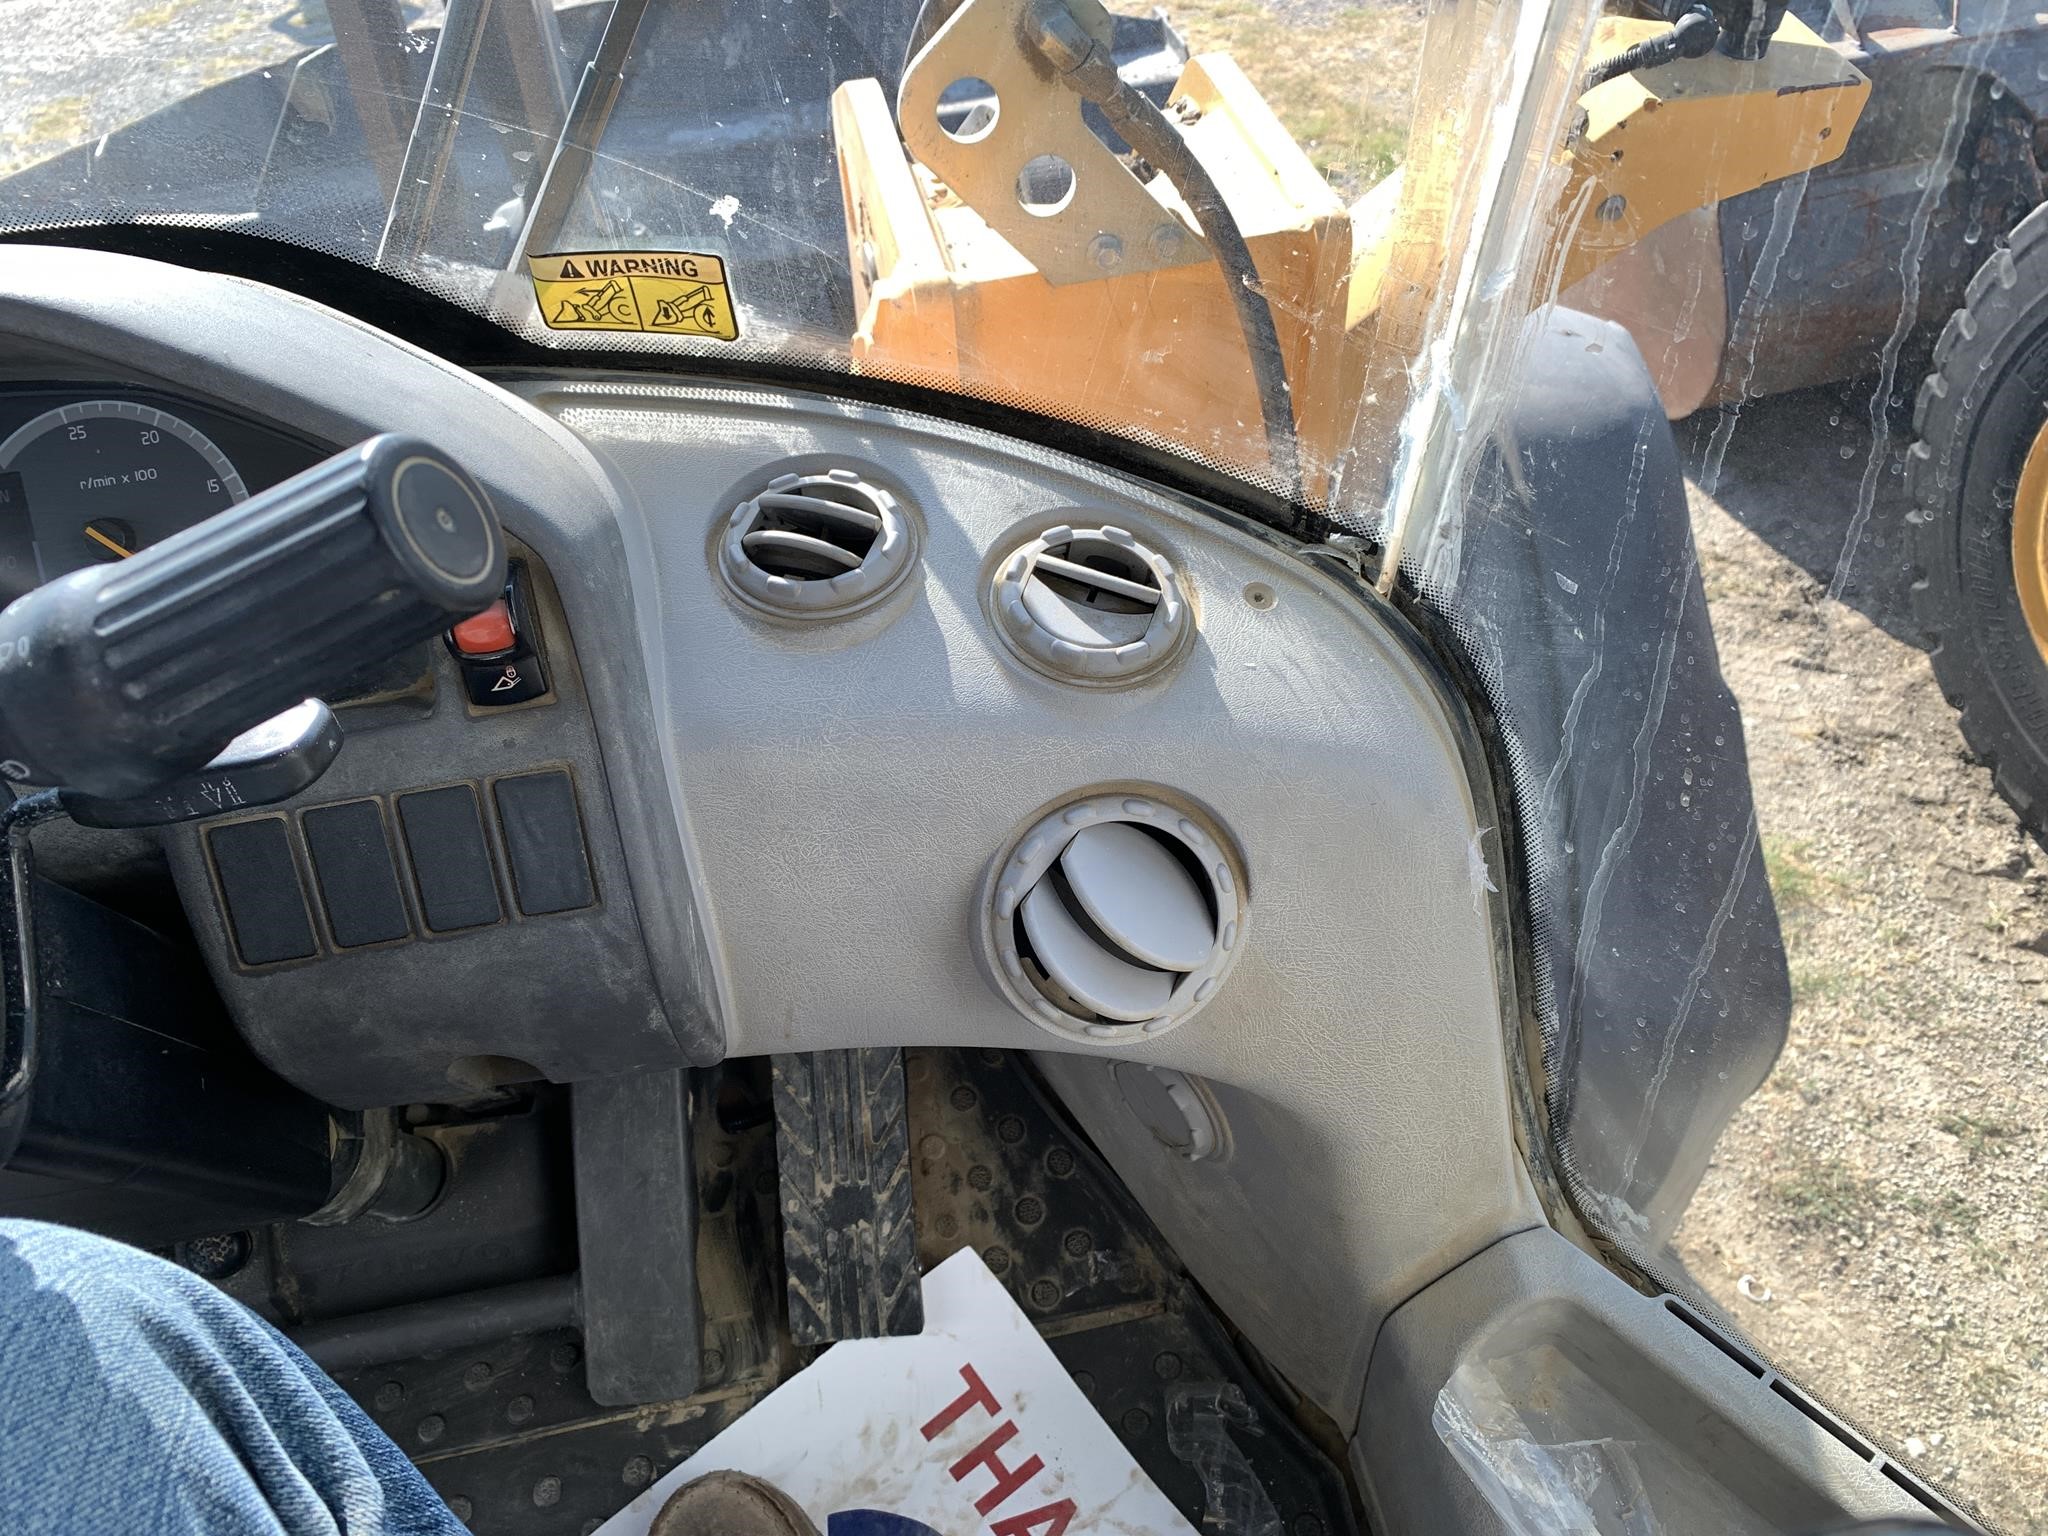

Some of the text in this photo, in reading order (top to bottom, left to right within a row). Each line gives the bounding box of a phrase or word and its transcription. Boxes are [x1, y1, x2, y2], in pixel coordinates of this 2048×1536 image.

[585, 258, 699, 277] WARNING
[67, 425, 87, 441] 25
[140, 430, 160, 446] 20
[79, 468, 158, 490] r/min x 100
[206, 478, 221, 494] 15
